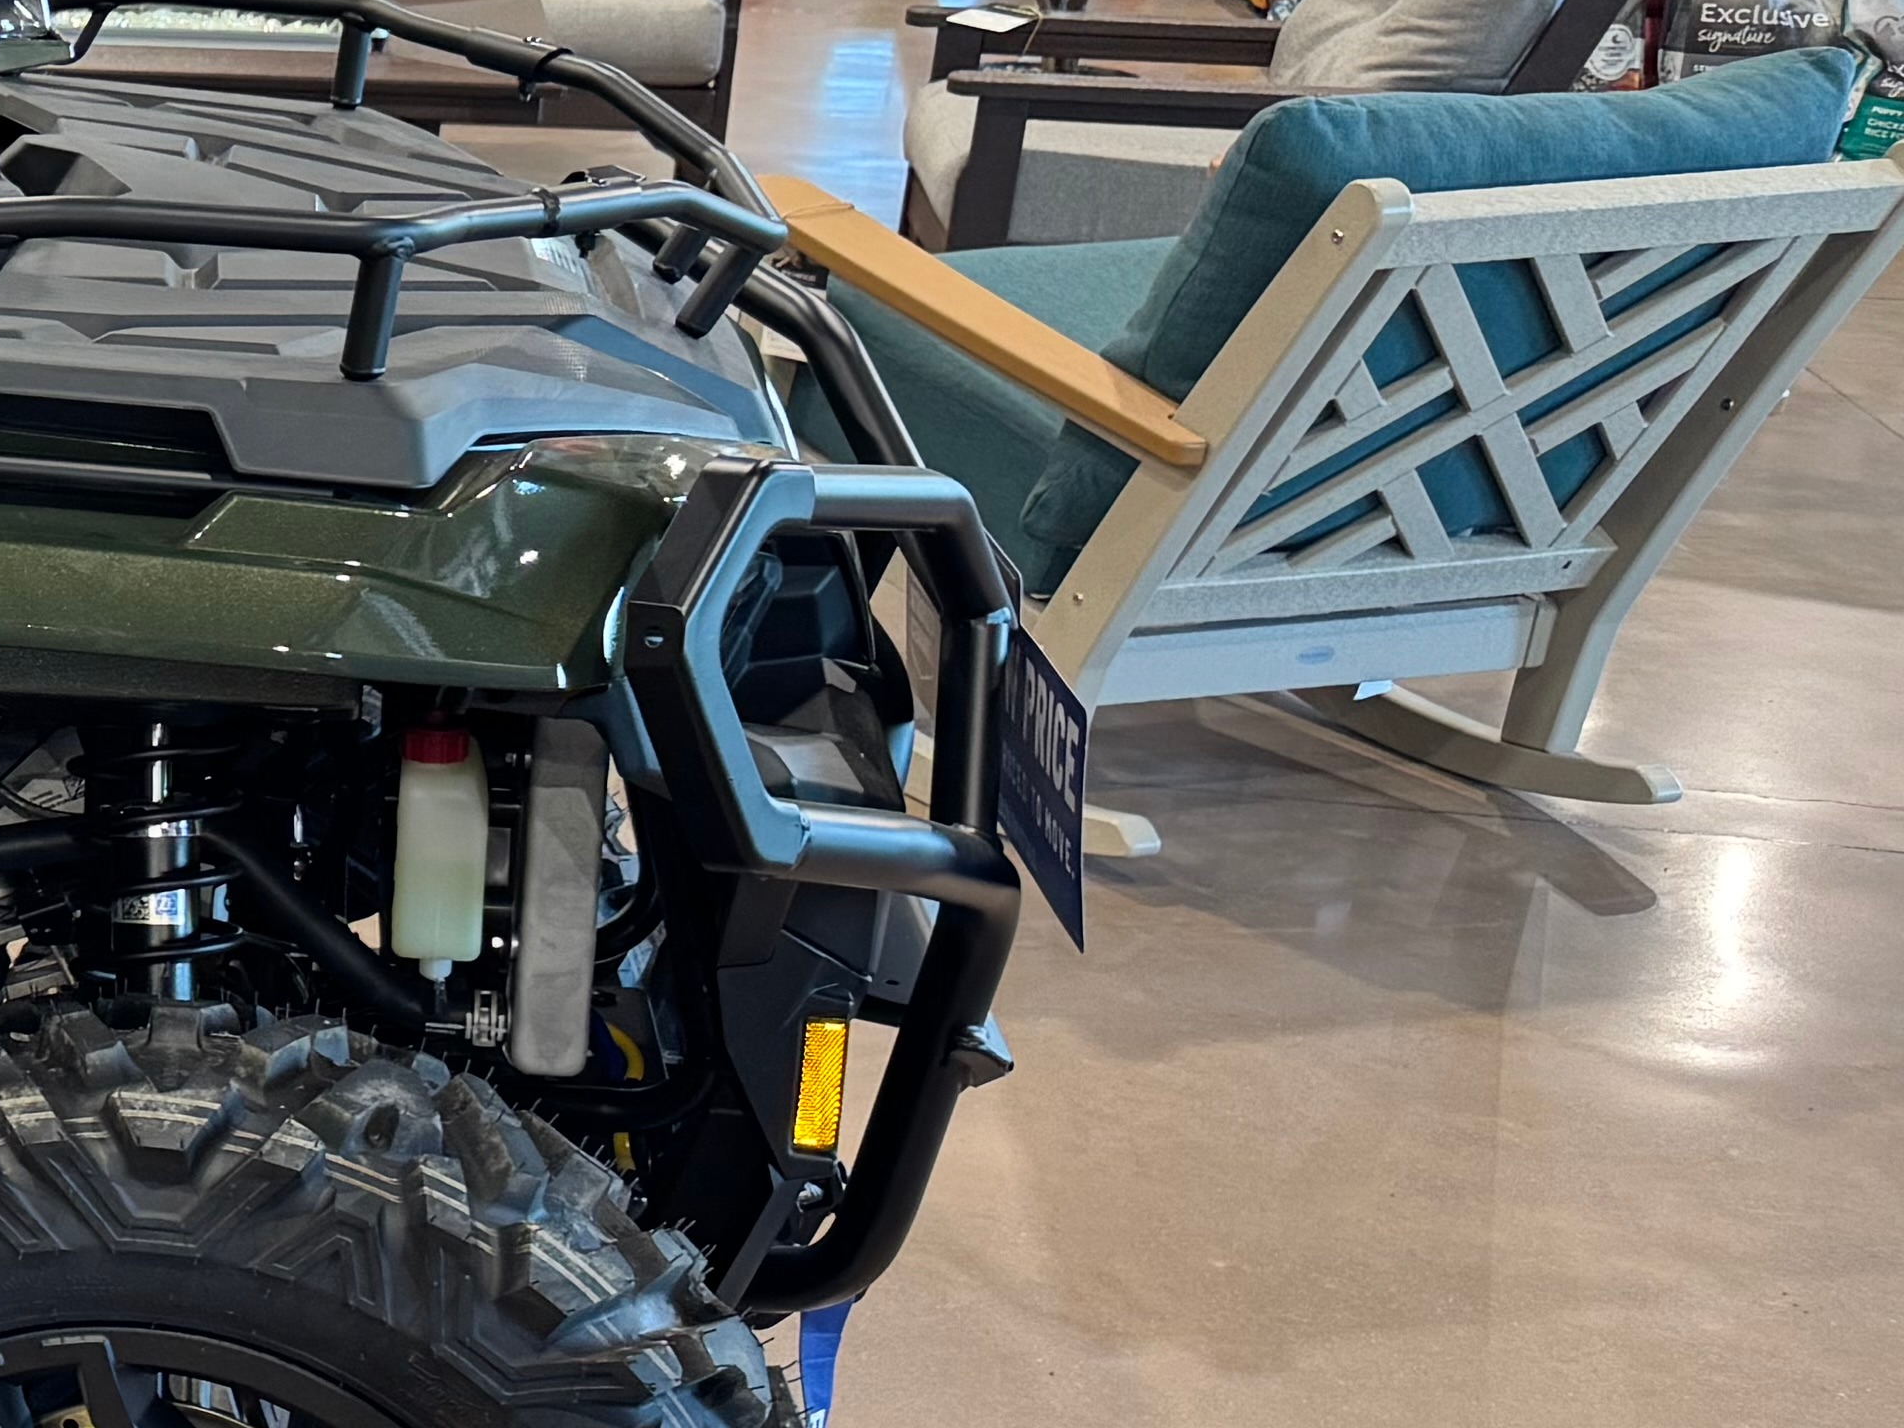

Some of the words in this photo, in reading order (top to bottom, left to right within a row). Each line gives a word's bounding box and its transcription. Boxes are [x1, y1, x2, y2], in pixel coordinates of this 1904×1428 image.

[1700, 3, 1830, 29] Exclusive
[1697, 27, 1777, 53] signature
[1022, 655, 1080, 814] PRICE
